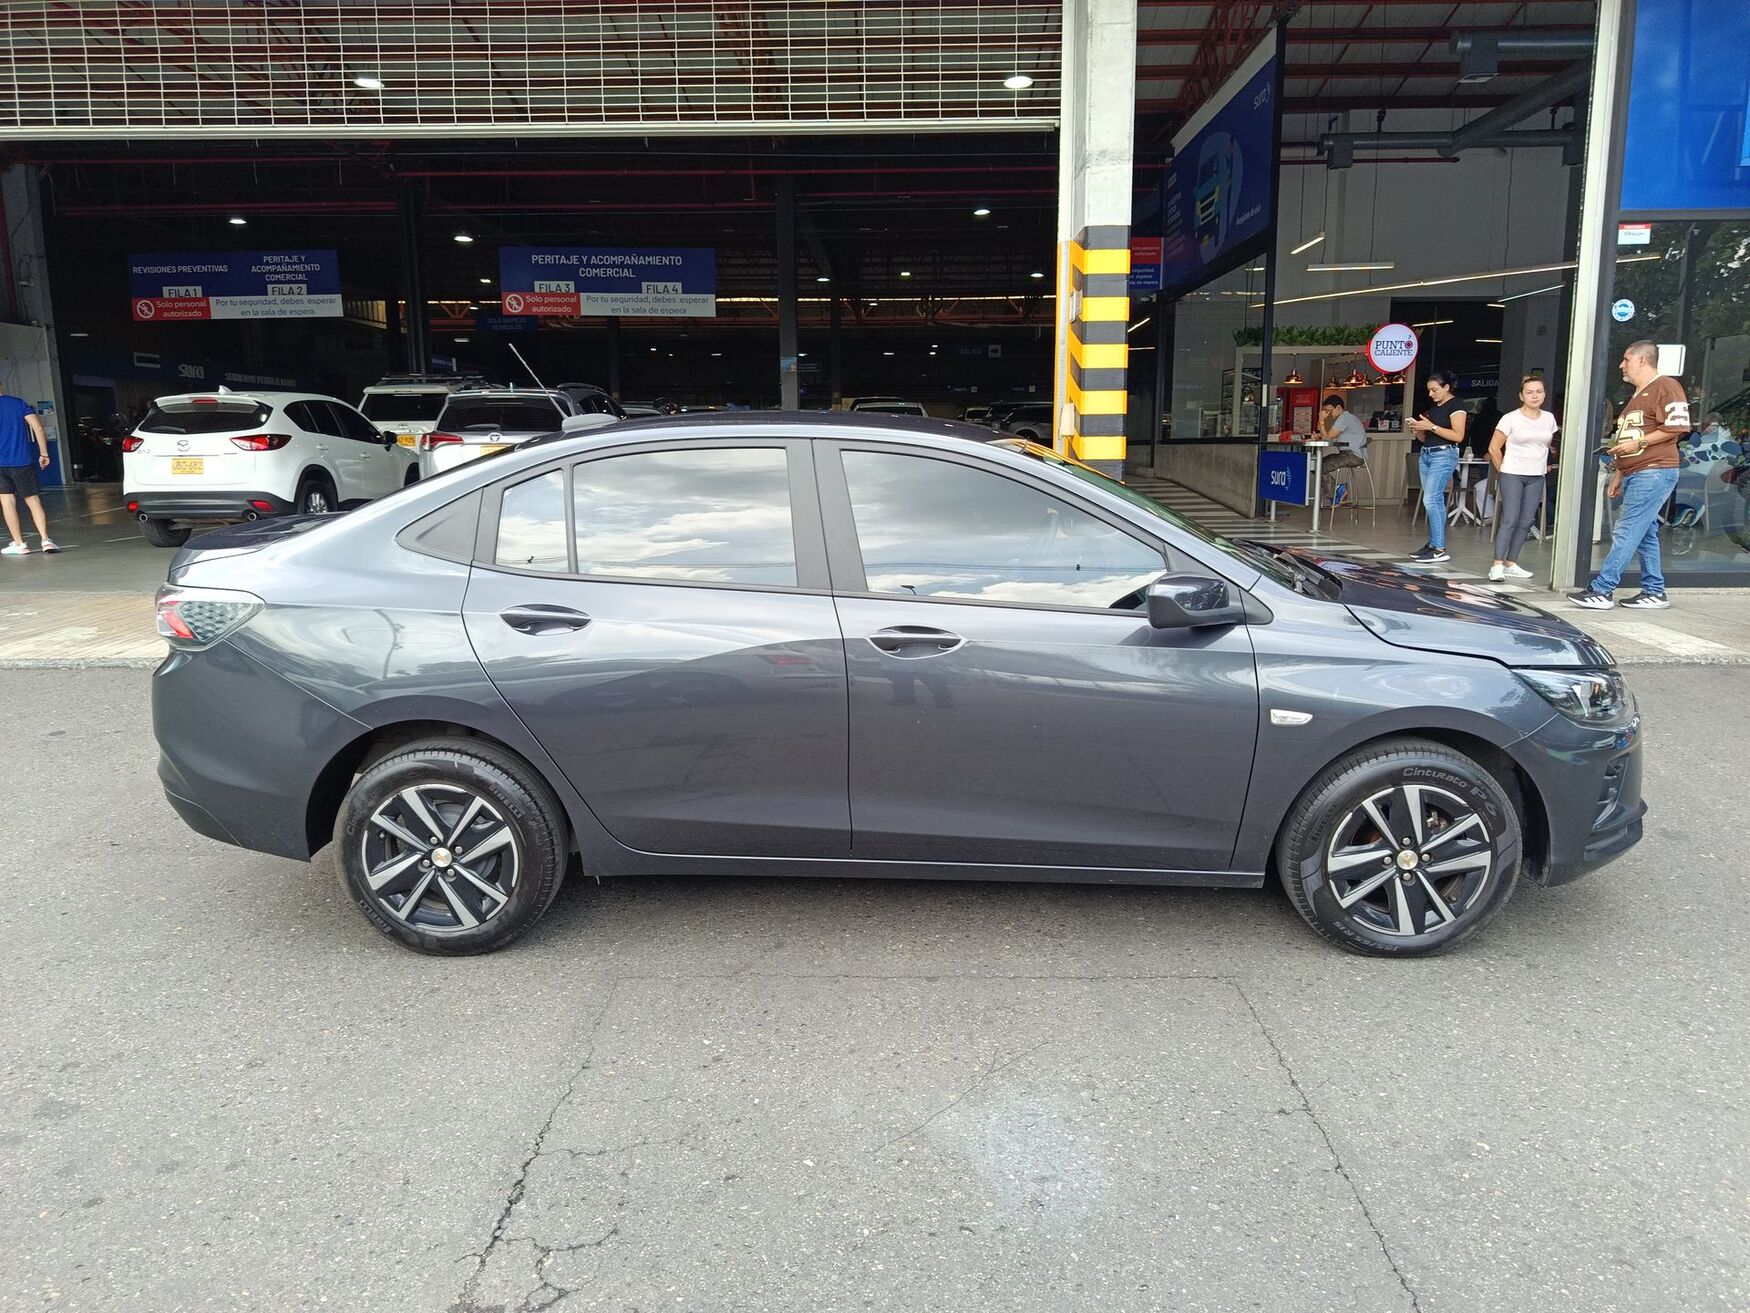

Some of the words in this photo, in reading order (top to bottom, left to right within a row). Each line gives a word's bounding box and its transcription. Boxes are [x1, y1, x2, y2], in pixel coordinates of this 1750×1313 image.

[263, 255, 299, 263] PERITAJE
[300, 255, 306, 263] Y
[531, 254, 580, 265] PERITAJE
[581, 254, 588, 265] Y
[590, 253, 682, 266] ACOMPAÑAMIENTO
[132, 265, 176, 274] REVISIONES
[177, 264, 228, 273] PREVENTIVAS
[251, 263, 320, 273] ACOMPAÑAMIENTO
[579, 267, 636, 278] COMERCIAL
[265, 273, 308, 281] COMERCIAL
[168, 288, 191, 298] FILA
[272, 286, 295, 296] FILA
[296, 286, 304, 295] 2
[538, 283, 562, 293] FILA
[564, 283, 571, 293] 3
[646, 284, 670, 294] FILA
[671, 284, 679, 294] 4
[281, 297, 303, 305] debes
[307, 298, 336, 307] esperar
[526, 295, 542, 303] Solo
[544, 294, 577, 304] personal
[586, 295, 600, 303] Por
[601, 295, 609, 303] tu
[610, 295, 650, 305] seguridad,
[652, 295, 676, 304] debes
[680, 297, 709, 306] esperar
[156, 300, 172, 308] Solo
[173, 300, 207, 309] personal
[531, 304, 572, 313] autorizado
[162, 310, 202, 318] autorizado
[260, 308, 276, 316] sala
[291, 309, 315, 317] espera
[611, 306, 621, 314] en
[622, 305, 630, 314] la
[631, 305, 648, 314] sala
[649, 305, 659, 314] de
[660, 307, 687, 316] espera
[1375, 340, 1413, 349] PUNTO
[178, 364, 205, 379] sura
[1471, 379, 1499, 387] SALIDA
[1271, 470, 1286, 486] sura
[1402, 767, 1468, 788] Cinturato
